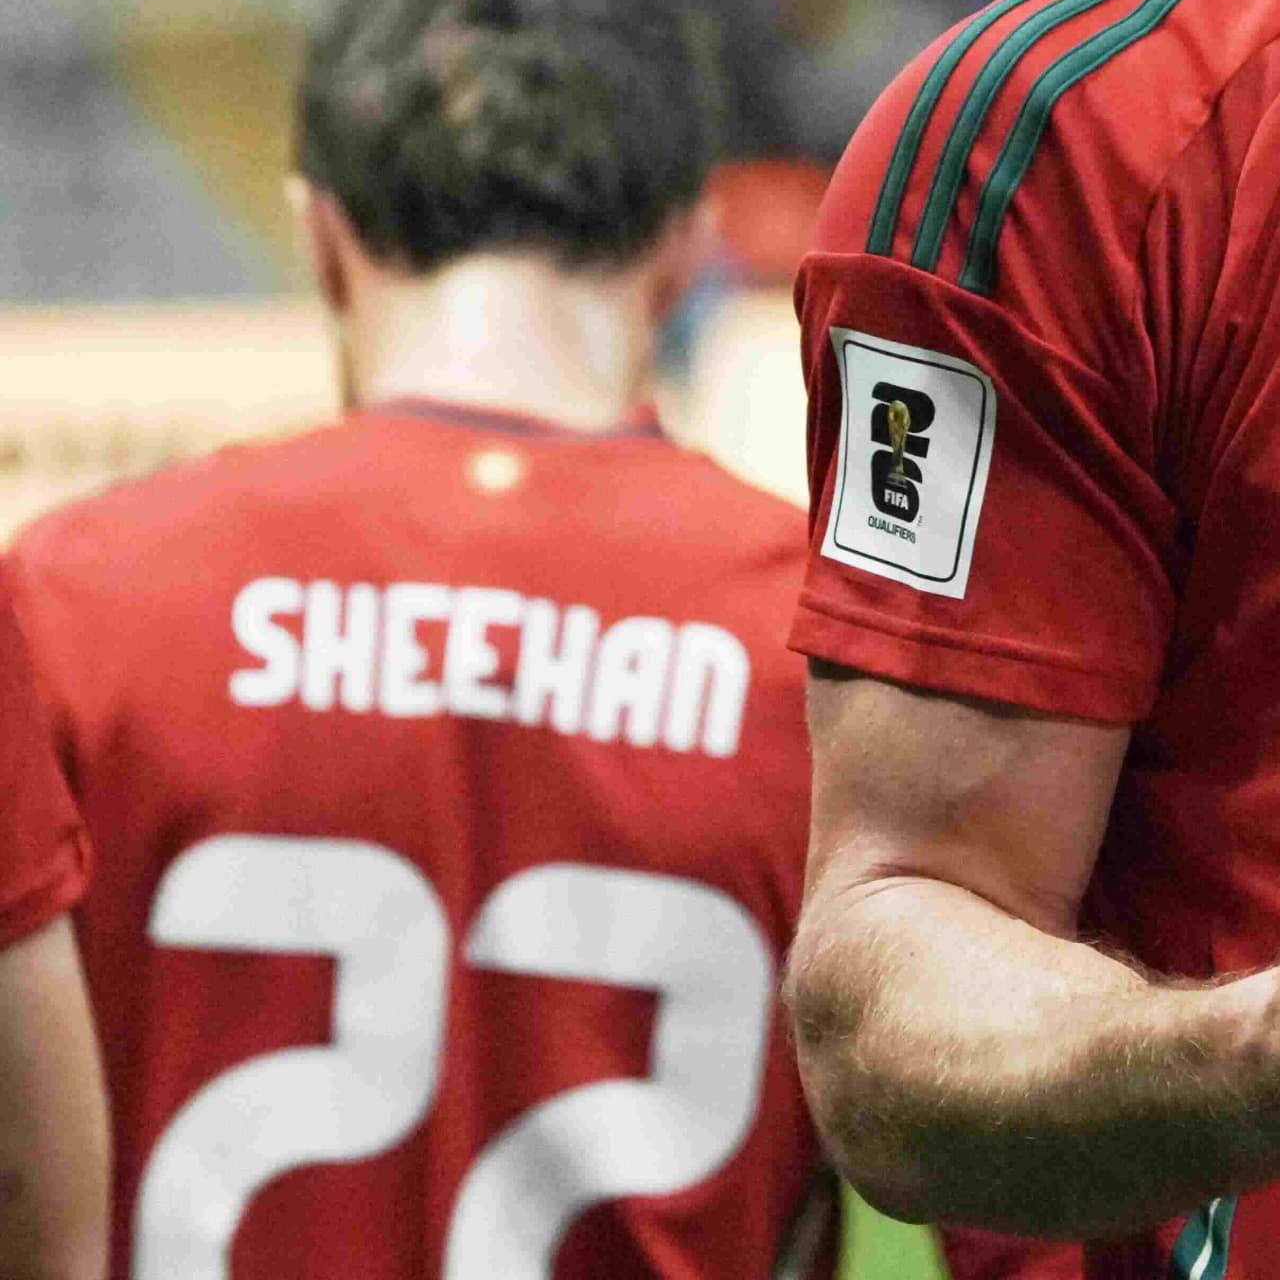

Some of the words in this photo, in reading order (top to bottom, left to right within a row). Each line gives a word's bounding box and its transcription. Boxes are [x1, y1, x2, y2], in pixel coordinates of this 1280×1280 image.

[867, 515, 916, 544] QUALIFIERS
[884, 489, 909, 511] FIFA
[230, 577, 750, 760] SHEEHAN
[131, 832, 776, 1280] 22
